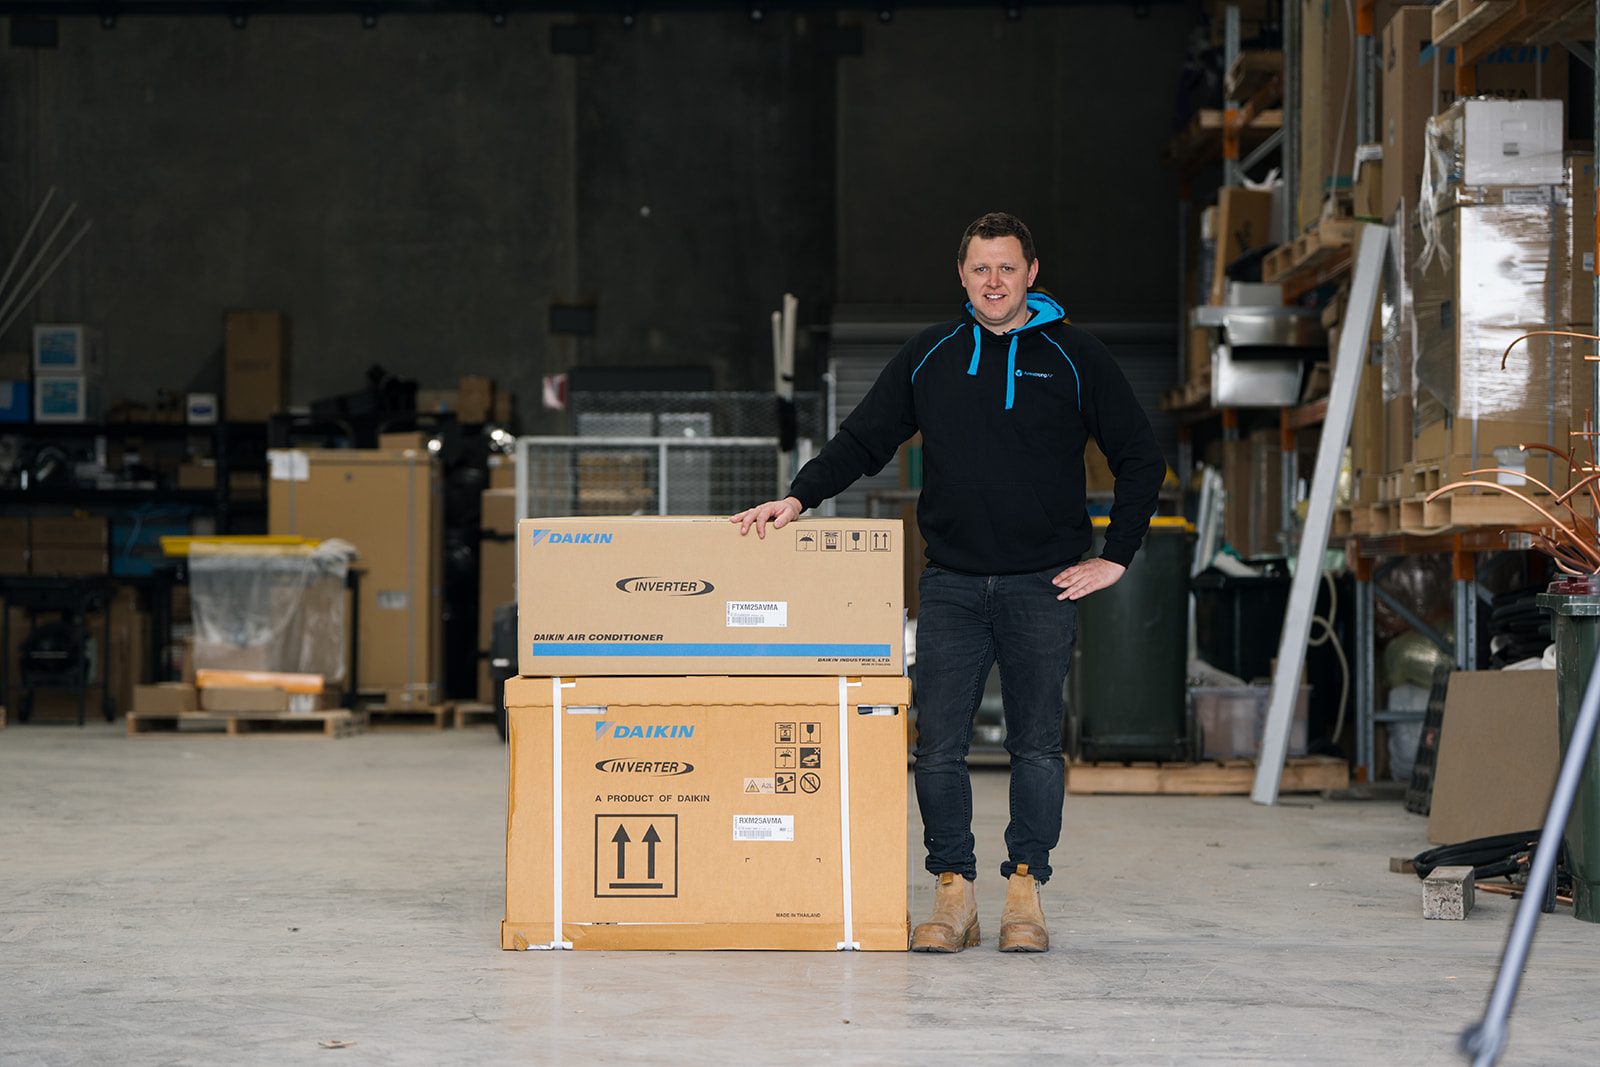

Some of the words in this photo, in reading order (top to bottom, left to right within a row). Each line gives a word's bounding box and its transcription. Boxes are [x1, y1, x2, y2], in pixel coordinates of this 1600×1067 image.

[548, 533, 613, 544] DAIKIN
[634, 581, 698, 592] INVERTER
[731, 603, 778, 611] FTXM25AVMA
[533, 633, 565, 641] DAIKIN
[566, 633, 586, 641] AIR
[588, 633, 664, 641] CONDITIONER
[613, 725, 695, 738] DAIKIN
[611, 761, 679, 773] INVERTER
[594, 794, 602, 803] A
[607, 794, 655, 803] PRODUCT
[658, 794, 673, 803] OF
[677, 794, 711, 803] DAIKIN
